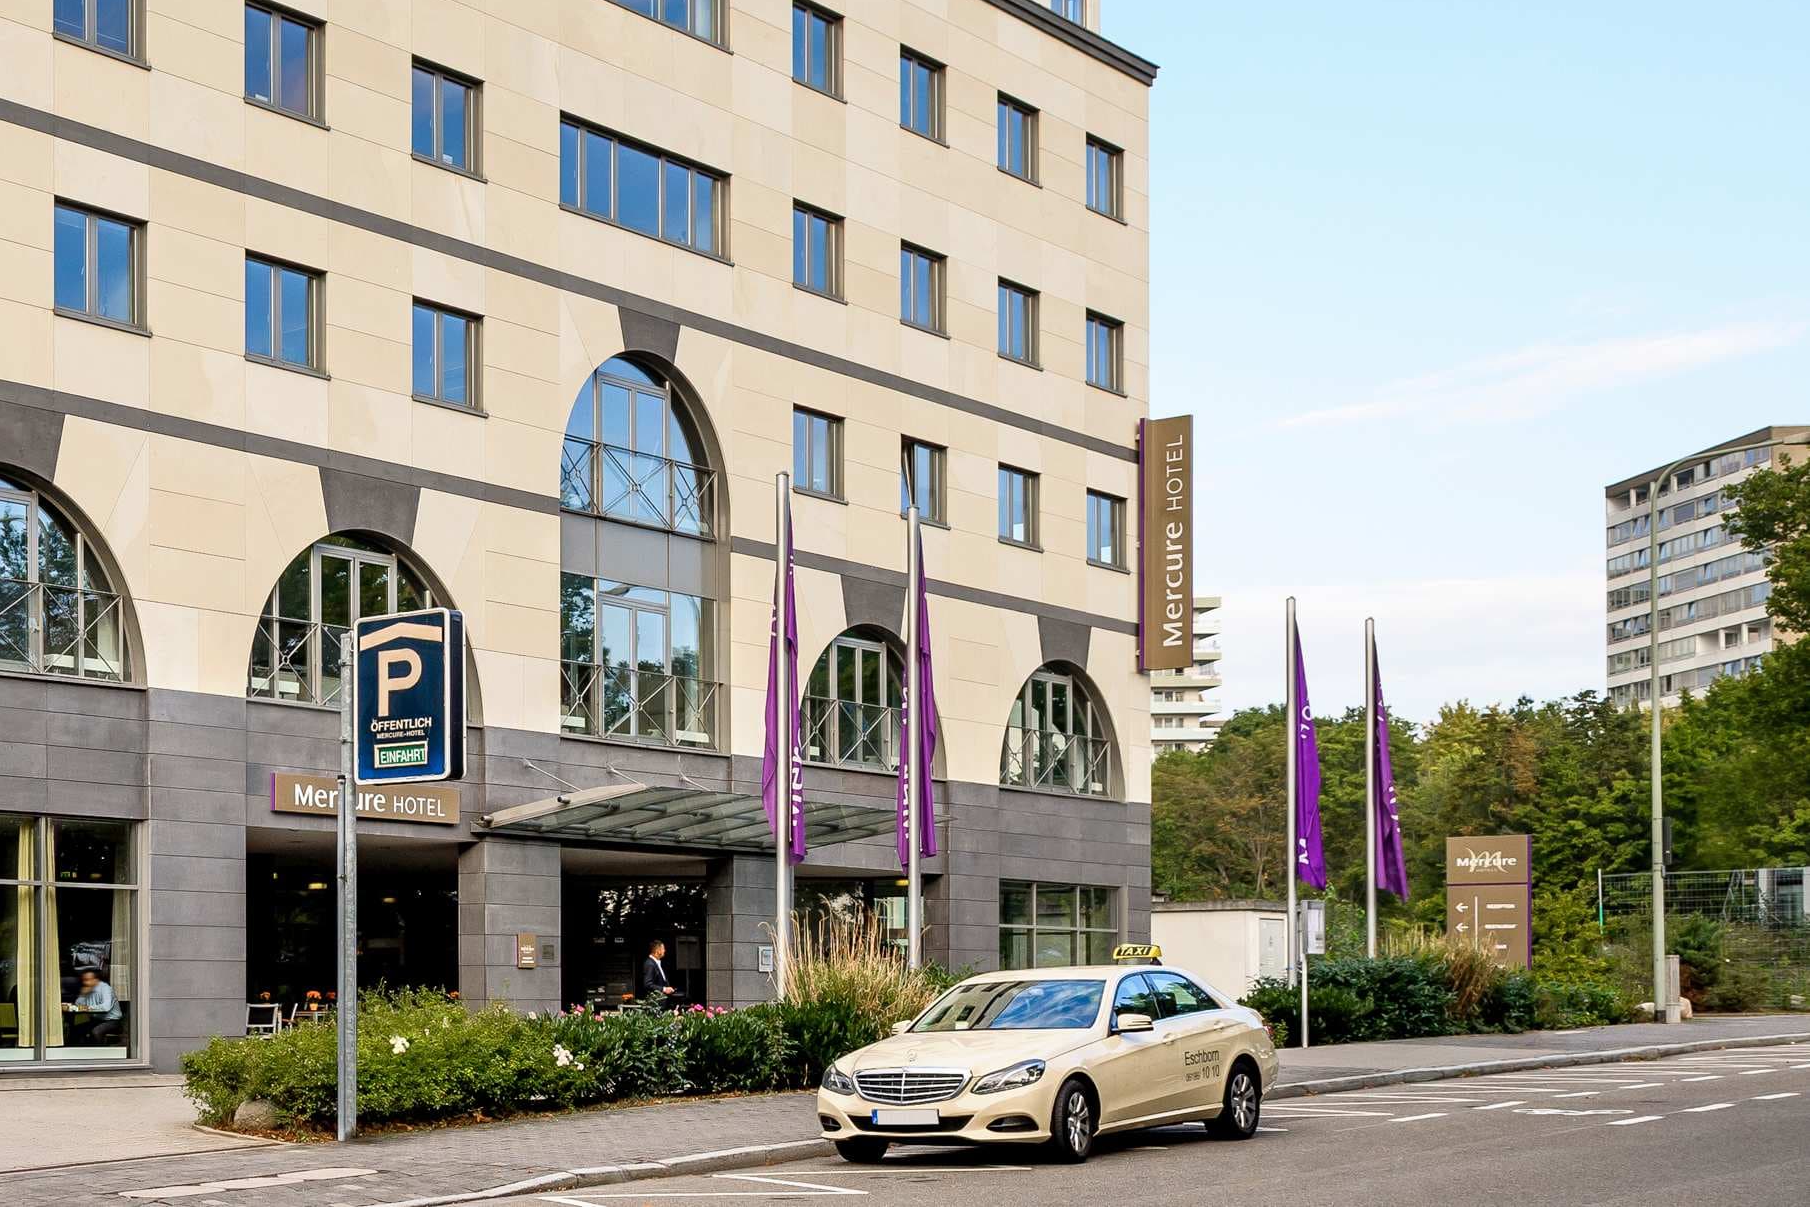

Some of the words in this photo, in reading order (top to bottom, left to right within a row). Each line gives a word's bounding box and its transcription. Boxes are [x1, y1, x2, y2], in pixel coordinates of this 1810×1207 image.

[1166, 434, 1183, 511] HOTEL
[1163, 521, 1183, 647] Mercure
[377, 648, 422, 717] P
[370, 717, 432, 732] ÖFFENTLICH
[376, 730, 425, 739] MERCURE-HOTEL
[380, 748, 426, 764] EINFAHRT
[294, 783, 386, 812] Merure
[393, 796, 445, 817] HOTEL
[1456, 857, 1517, 867] Mercure
[1120, 947, 1148, 955] TAXI
[1184, 1050, 1220, 1066] Eschborn
[1202, 1066, 1210, 1079] 10
[1212, 1065, 1220, 1078] 10
